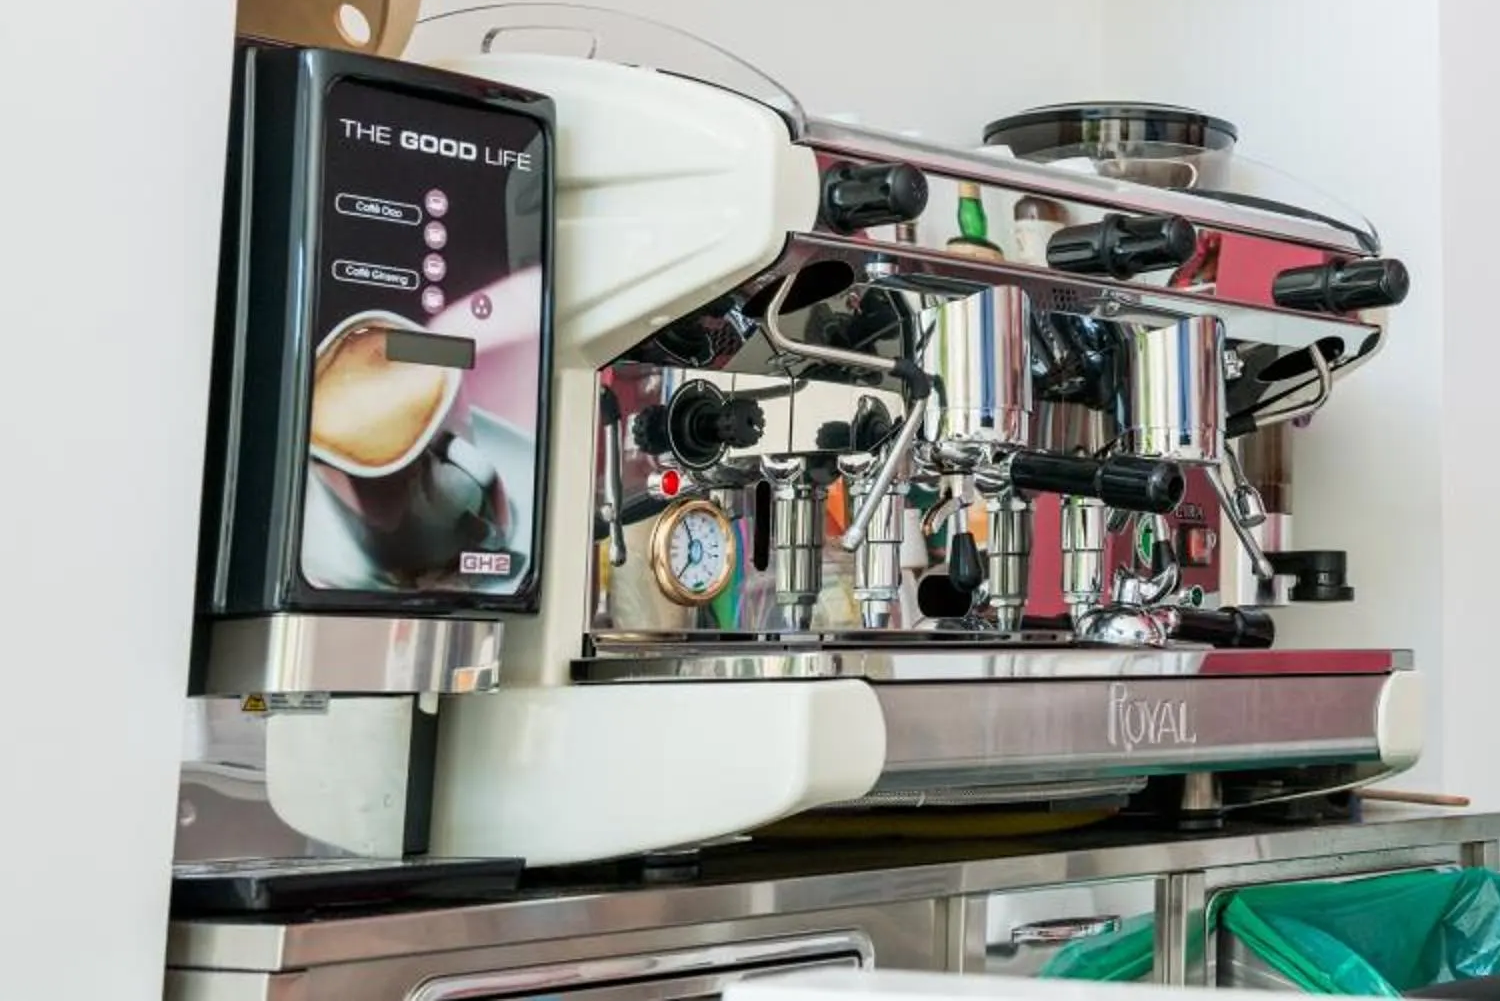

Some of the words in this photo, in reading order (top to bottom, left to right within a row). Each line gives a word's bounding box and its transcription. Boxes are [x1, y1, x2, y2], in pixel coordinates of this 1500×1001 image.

[339, 118, 392, 146] THE
[400, 130, 477, 161] GOOD
[485, 146, 532, 172] LIFE
[463, 554, 508, 572] GH2
[1107, 682, 1197, 755] ROYAL
